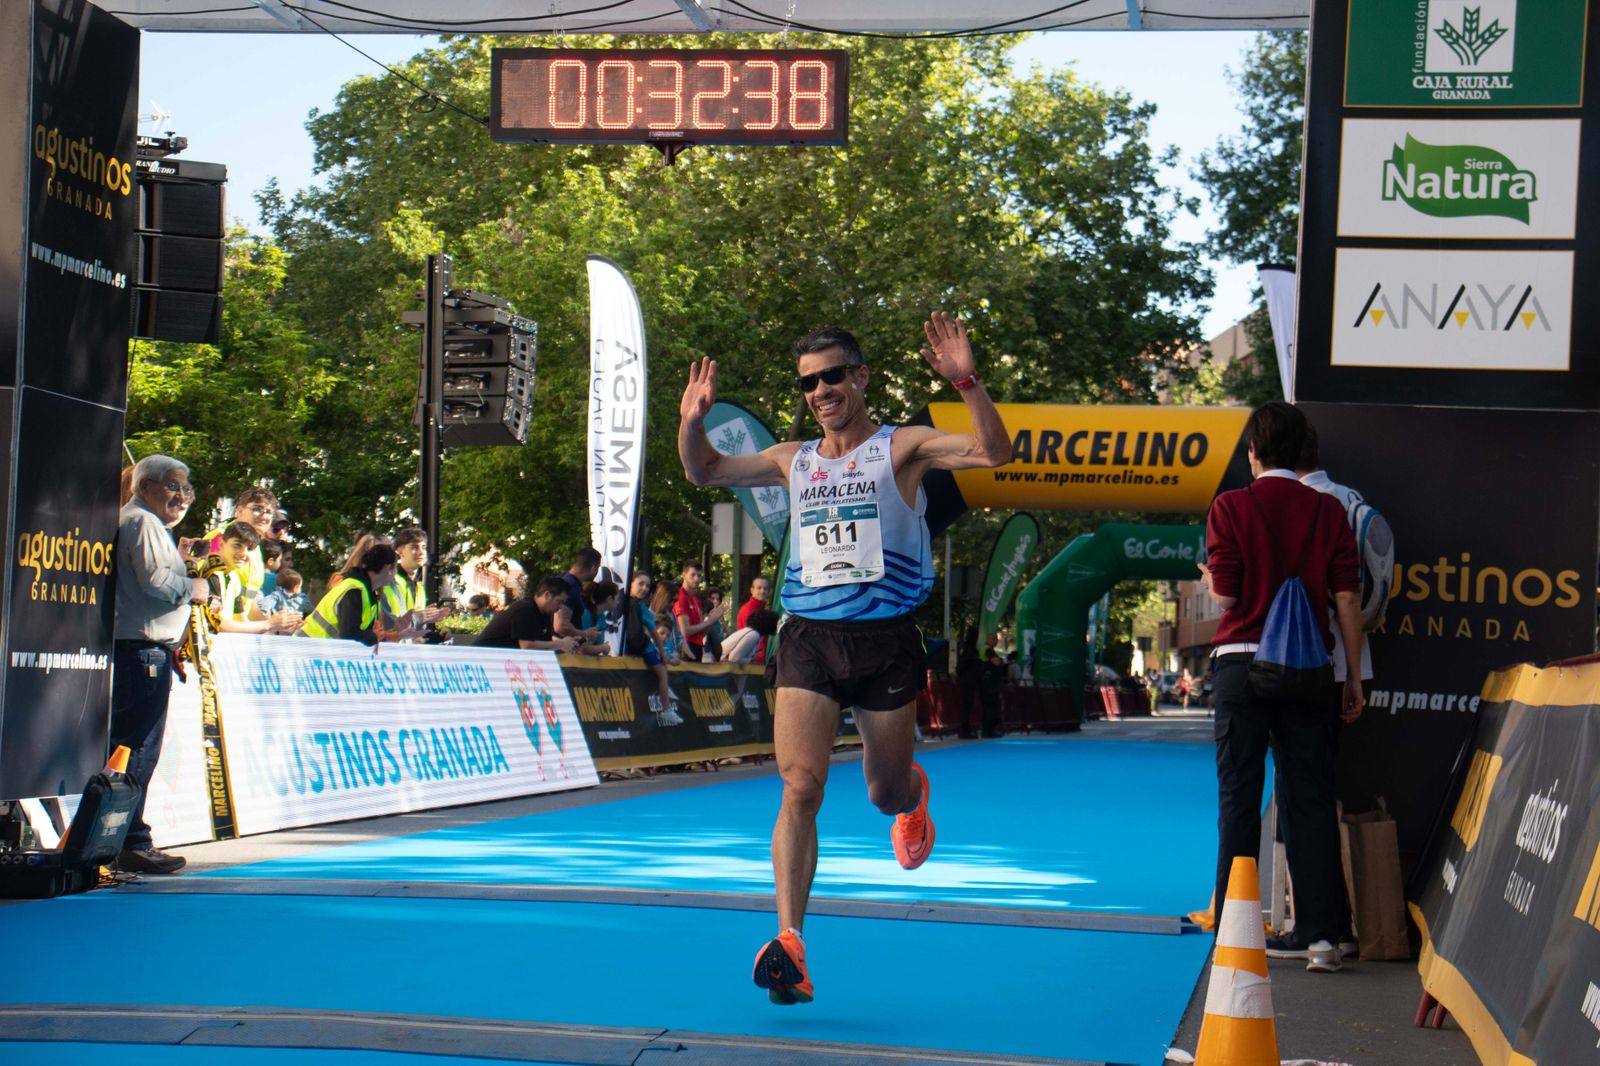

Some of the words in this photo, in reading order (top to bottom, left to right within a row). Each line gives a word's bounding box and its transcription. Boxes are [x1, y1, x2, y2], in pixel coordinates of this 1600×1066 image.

[1412, 1, 1427, 73] fundación
[547, 58, 829, 131] 00:32:38
[1412, 75, 1450, 89] CAJA
[1455, 75, 1513, 89] RURAL
[1432, 90, 1491, 100] GRANADA
[34, 122, 132, 197] agustinos
[1463, 158, 1503, 170] Sierra
[46, 176, 113, 221] GRANADA
[1384, 161, 1535, 201] Natura
[31, 241, 126, 290] www.mpmarcelino.es
[1352, 281, 1553, 332] ANAYA
[1008, 429, 1208, 468] ARCELINO
[799, 480, 877, 503] MARACENA
[993, 470, 1180, 487] www.mpmarcelino.es
[815, 521, 857, 546] 611
[820, 544, 856, 554] LEONARDO
[1123, 536, 1145, 559] El
[1145, 538, 1193, 561] Corte
[17, 526, 113, 582] agustinos
[31, 579, 97, 605] GRANADA
[1372, 615, 1530, 642] RANADA
[11, 646, 108, 675] www.mpmarcelino.es
[281, 657, 340, 695] SANTO
[410, 662, 493, 695] VILLANUEVA
[573, 686, 635, 722] MARCELINO
[242, 730, 401, 798] AGUSTINOS
[398, 724, 510, 792] GRANADA
[207, 746, 228, 817] MARCELINO
